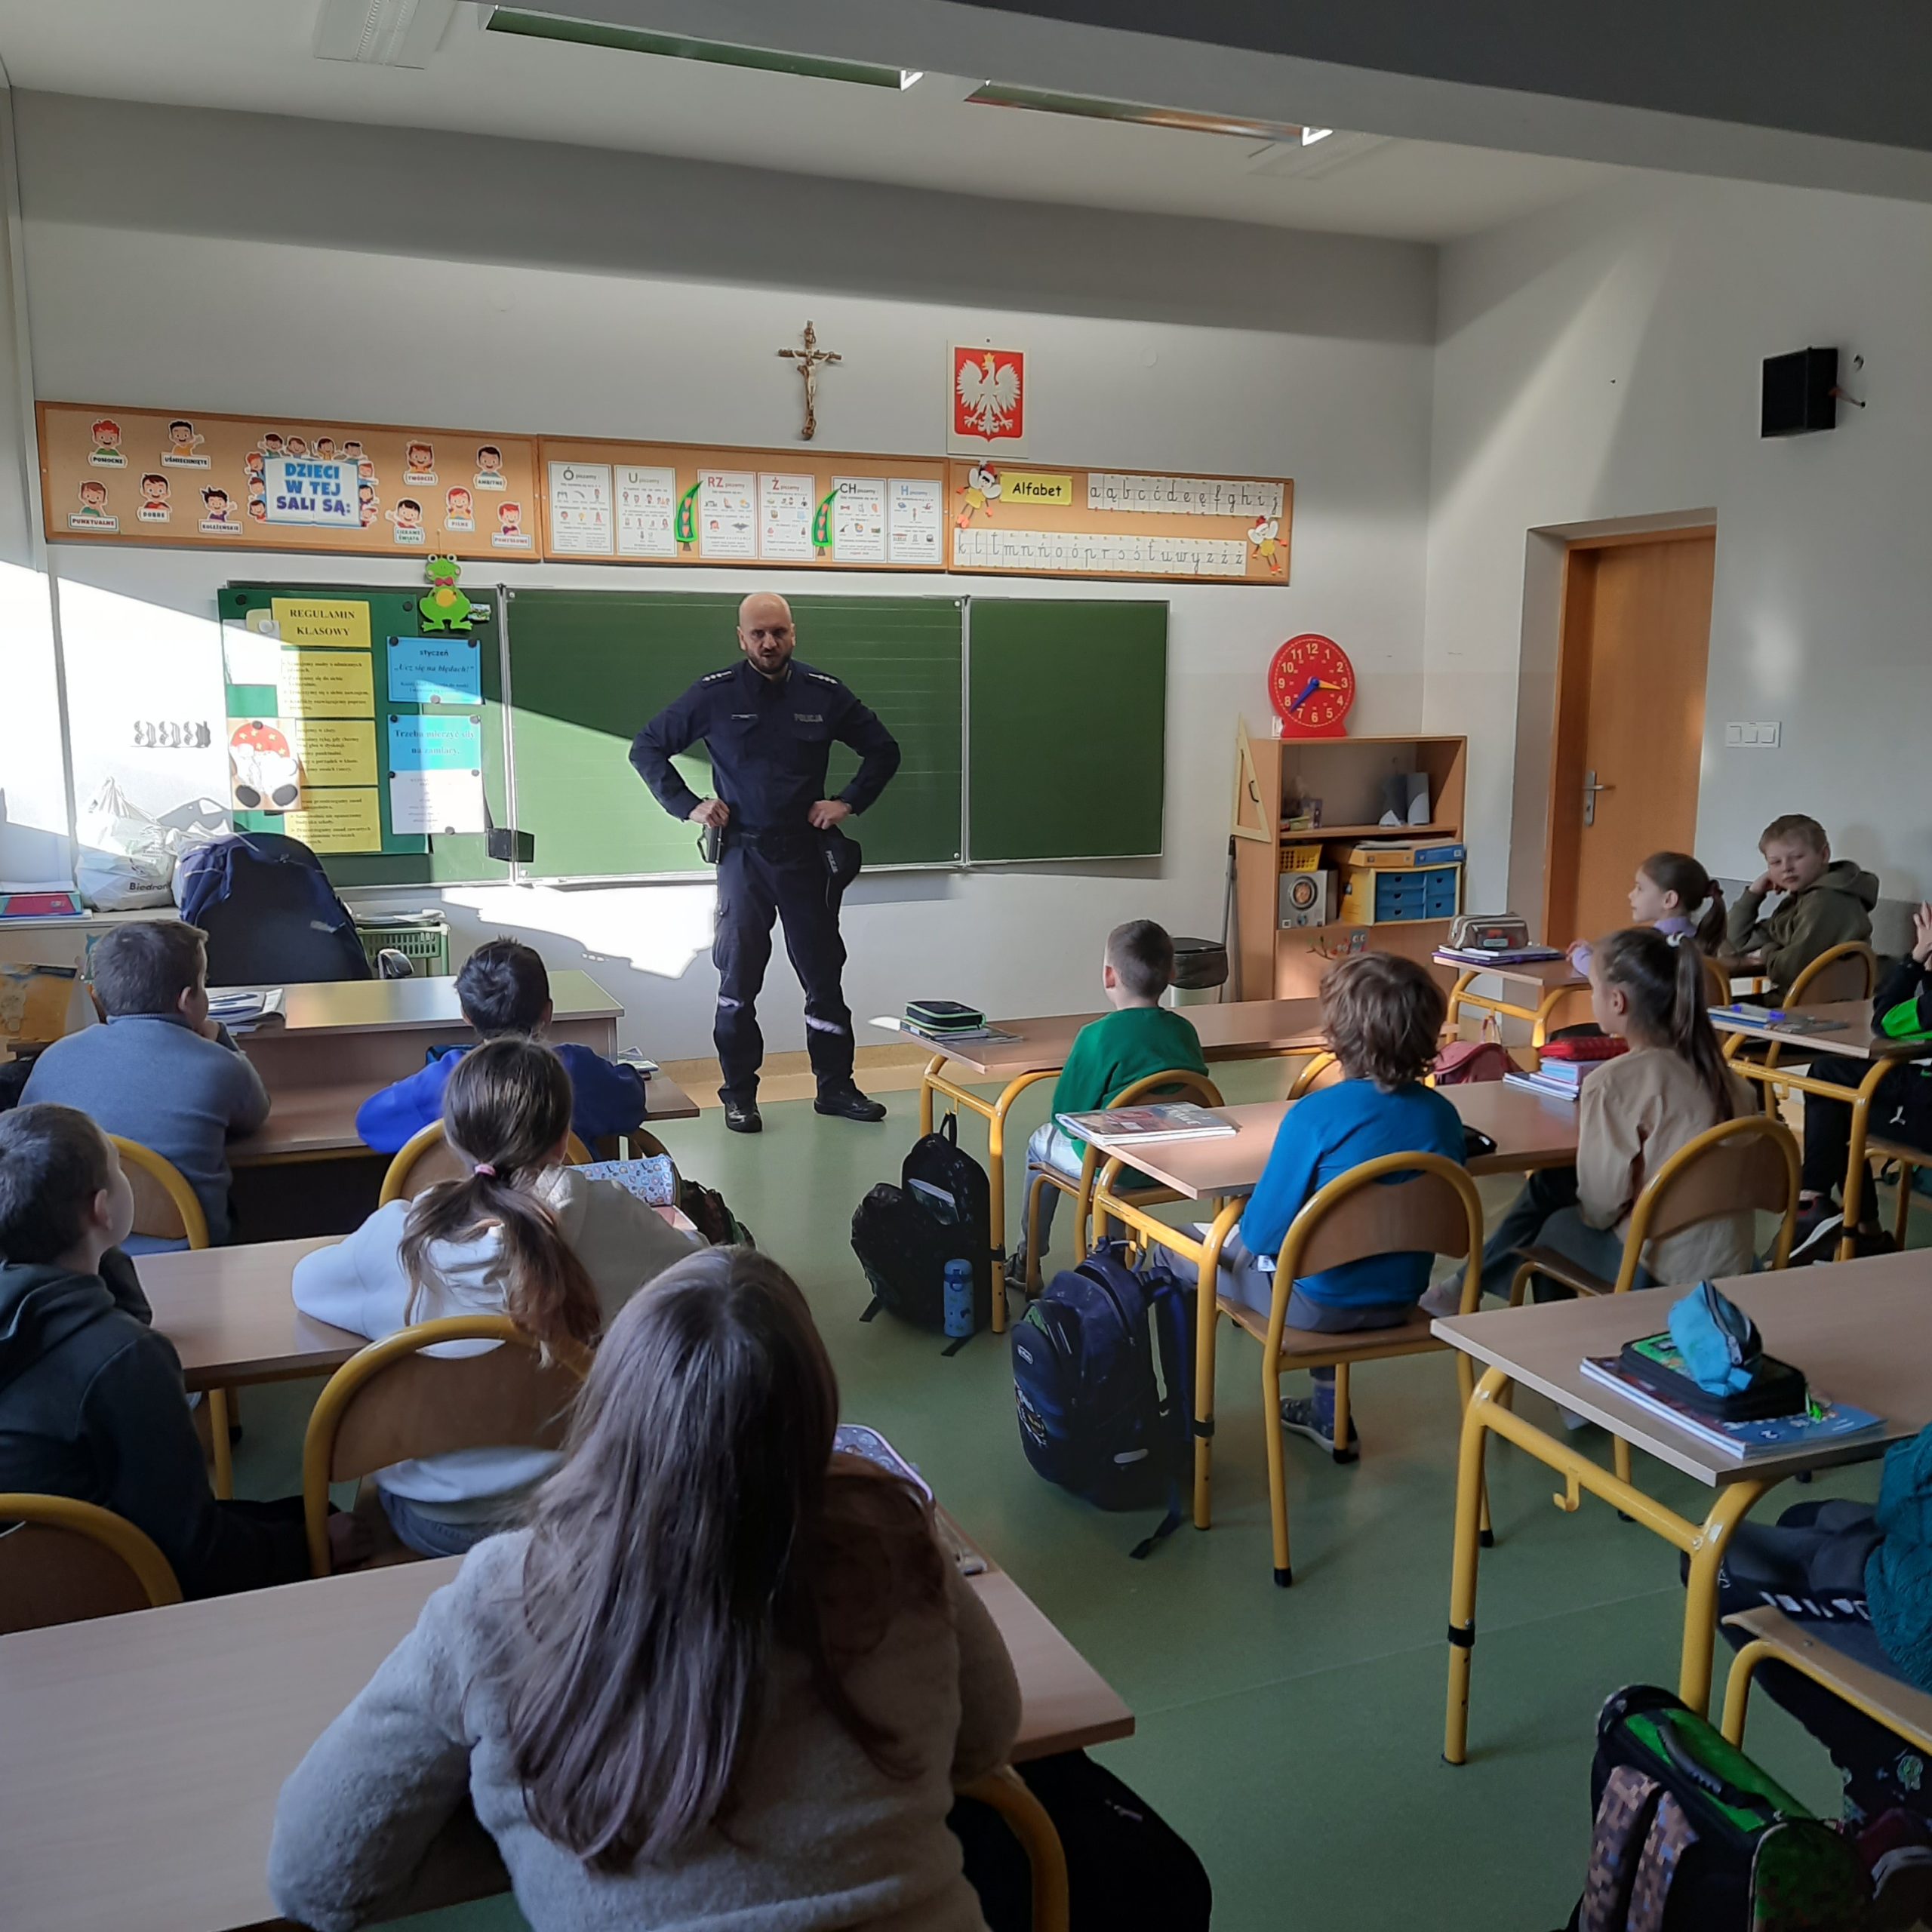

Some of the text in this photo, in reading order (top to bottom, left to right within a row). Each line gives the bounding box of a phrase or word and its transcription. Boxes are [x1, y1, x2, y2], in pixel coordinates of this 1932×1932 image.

[285, 462, 340, 479] DZIECI
[563, 466, 574, 481] Ó
[628, 472, 638, 484] U
[707, 476, 724, 488] RZ
[286, 479, 340, 497] W TEJ
[771, 477, 780, 491] Ż
[839, 483, 857, 494] CH
[1012, 481, 1062, 497] Alfabet
[900, 485, 909, 496] H
[1090, 479, 1278, 515] a ą b c ć d e ę f g h i j
[276, 496, 351, 516] SALI SĄ:
[72, 518, 115, 526] PUNKTUALNE
[290, 609, 355, 619] REGULAMIN
[297, 626, 349, 636] KLASOWY
[420, 649, 448, 657] styczeń
[1306, 643, 1319, 654] 12
[1291, 649, 1303, 660] 11
[1324, 649, 1331, 660] 1
[414, 665, 425, 673] się
[1281, 662, 1294, 673] 10
[1337, 662, 1343, 672] 2
[1278, 678, 1285, 688] 9
[1341, 678, 1348, 688] 3
[1284, 696, 1291, 706] 8
[1337, 695, 1343, 706] 4
[1297, 708, 1303, 718] 7
[1312, 712, 1318, 723] 6
[1326, 708, 1333, 718] 5
[394, 729, 475, 739] Trzeba mierzyć siły
